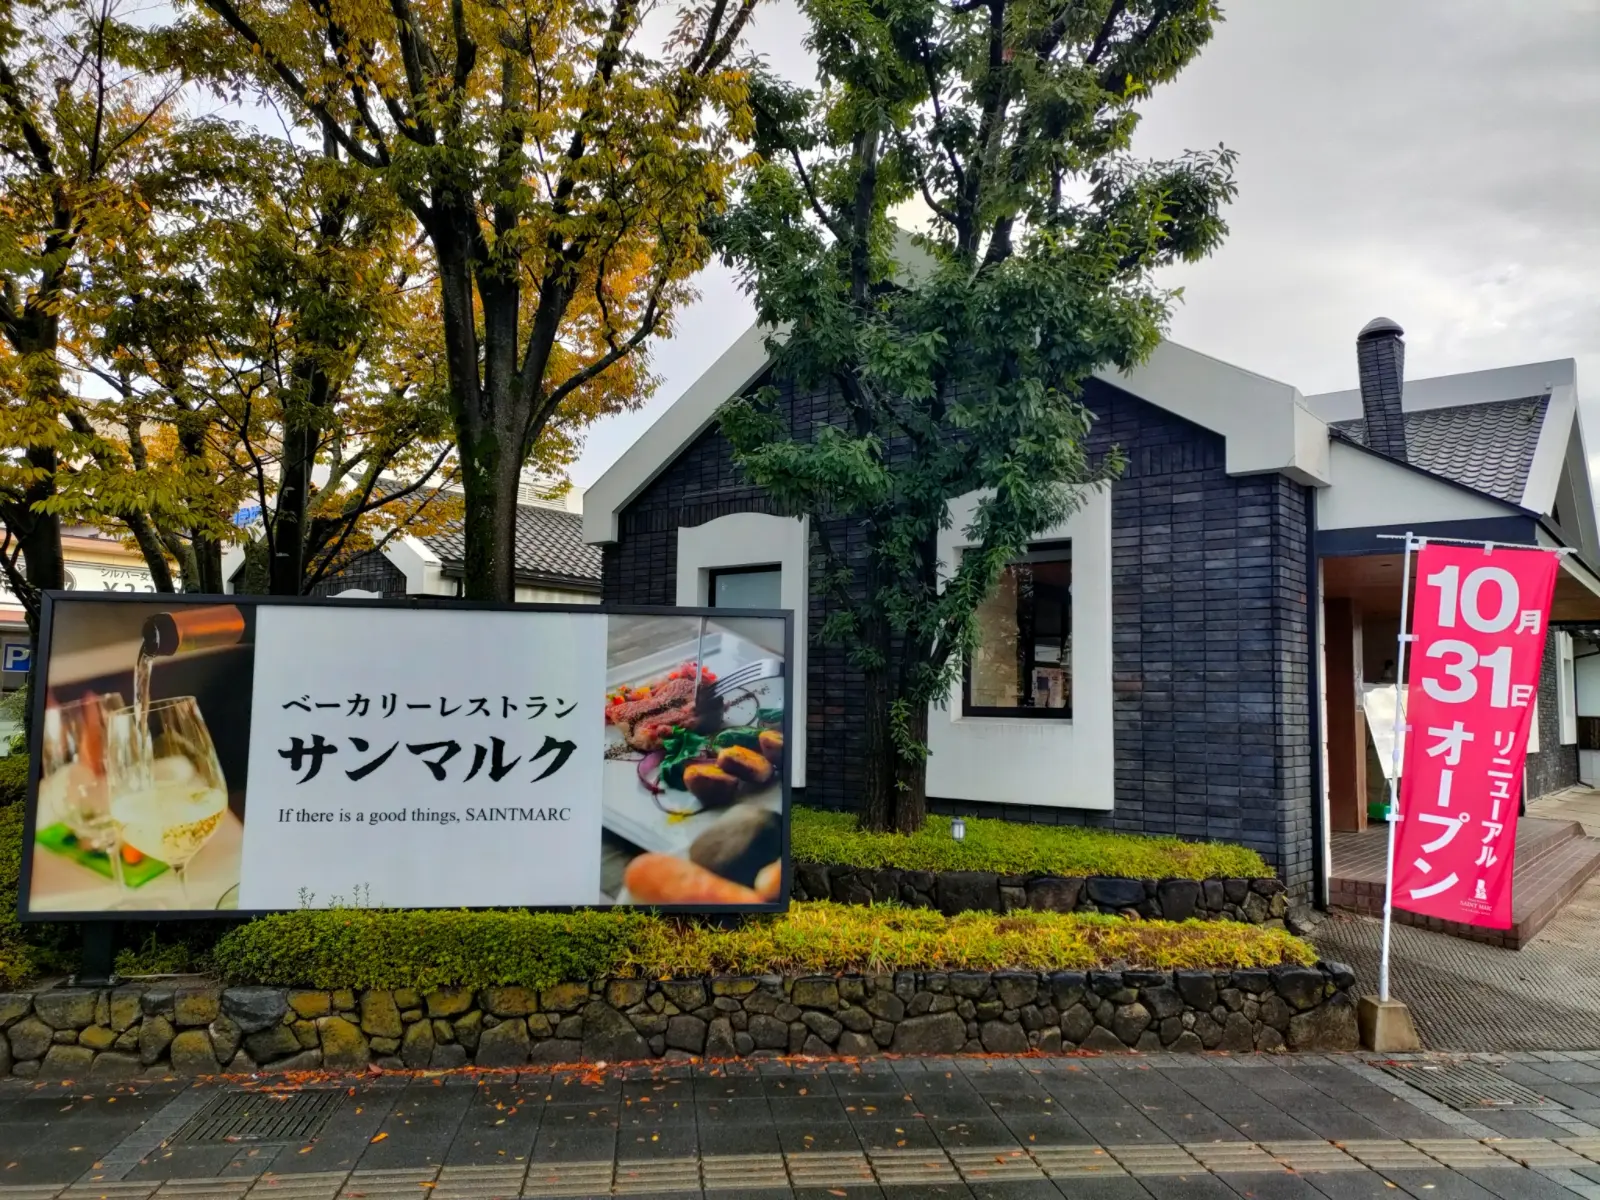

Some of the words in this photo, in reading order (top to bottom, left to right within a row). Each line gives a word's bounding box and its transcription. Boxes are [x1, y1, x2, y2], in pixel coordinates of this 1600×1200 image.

[1427, 565, 1541, 635] 10月
[6, 646, 30, 668] P
[1421, 639, 1534, 708] 31日
[281, 693, 579, 720] ベーカリーレストラン
[277, 733, 578, 785] サンマルク
[278, 808, 294, 822] If
[296, 808, 334, 822] there
[339, 808, 351, 822] is
[356, 812, 364, 822] a
[368, 808, 407, 826] good
[411, 808, 461, 826] things,
[465, 807, 571, 822] SAINTMARC
[1409, 720, 1475, 900] オープン
[1474, 730, 1516, 868] リニューアル
